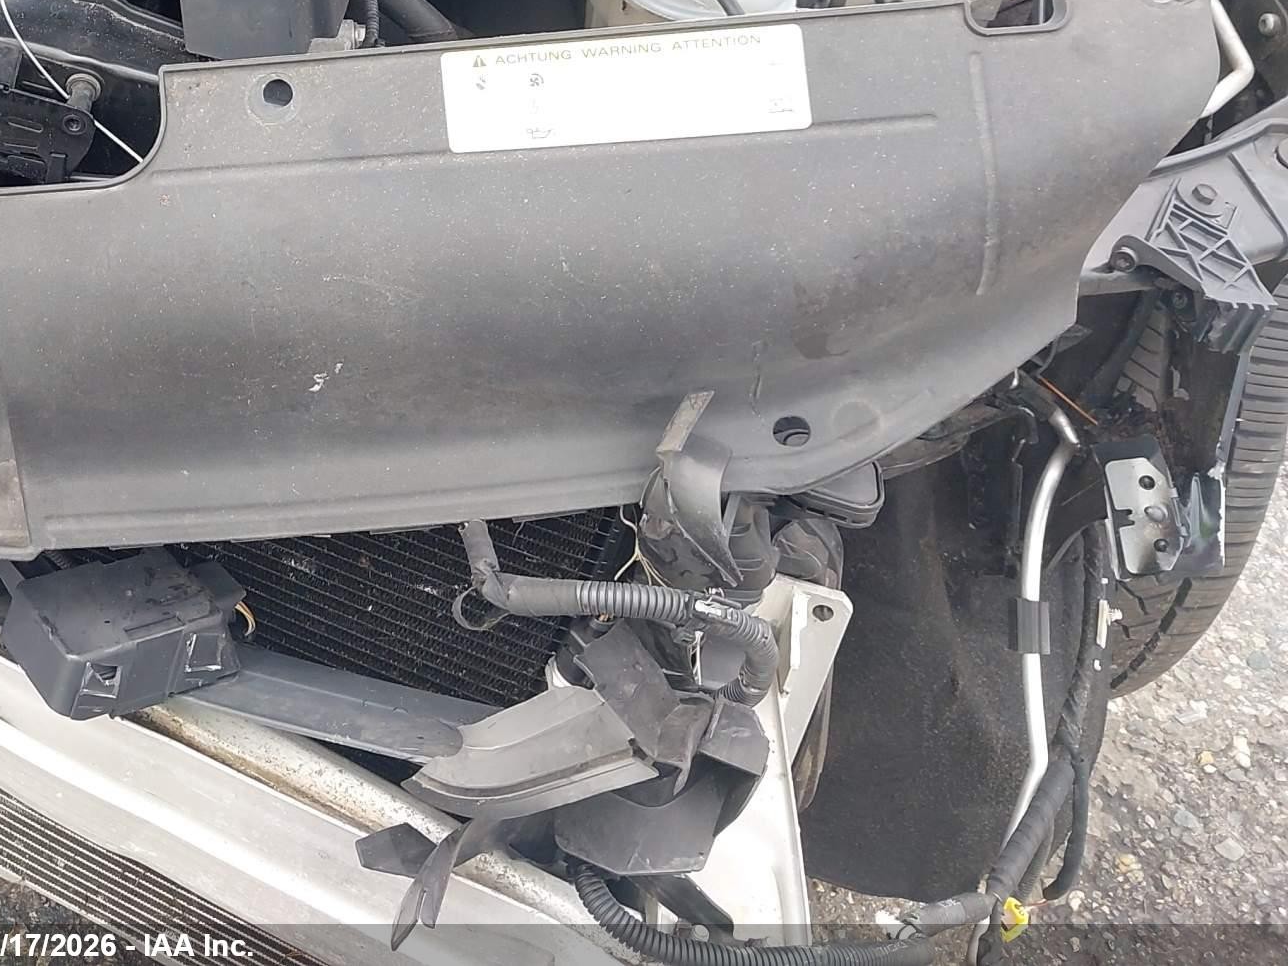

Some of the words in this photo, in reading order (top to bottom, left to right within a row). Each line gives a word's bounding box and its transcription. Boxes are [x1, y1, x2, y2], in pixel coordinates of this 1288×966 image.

[495, 49, 572, 65] ACHTUNG
[582, 42, 662, 59] WARNING
[672, 34, 761, 51] ATTENTION
